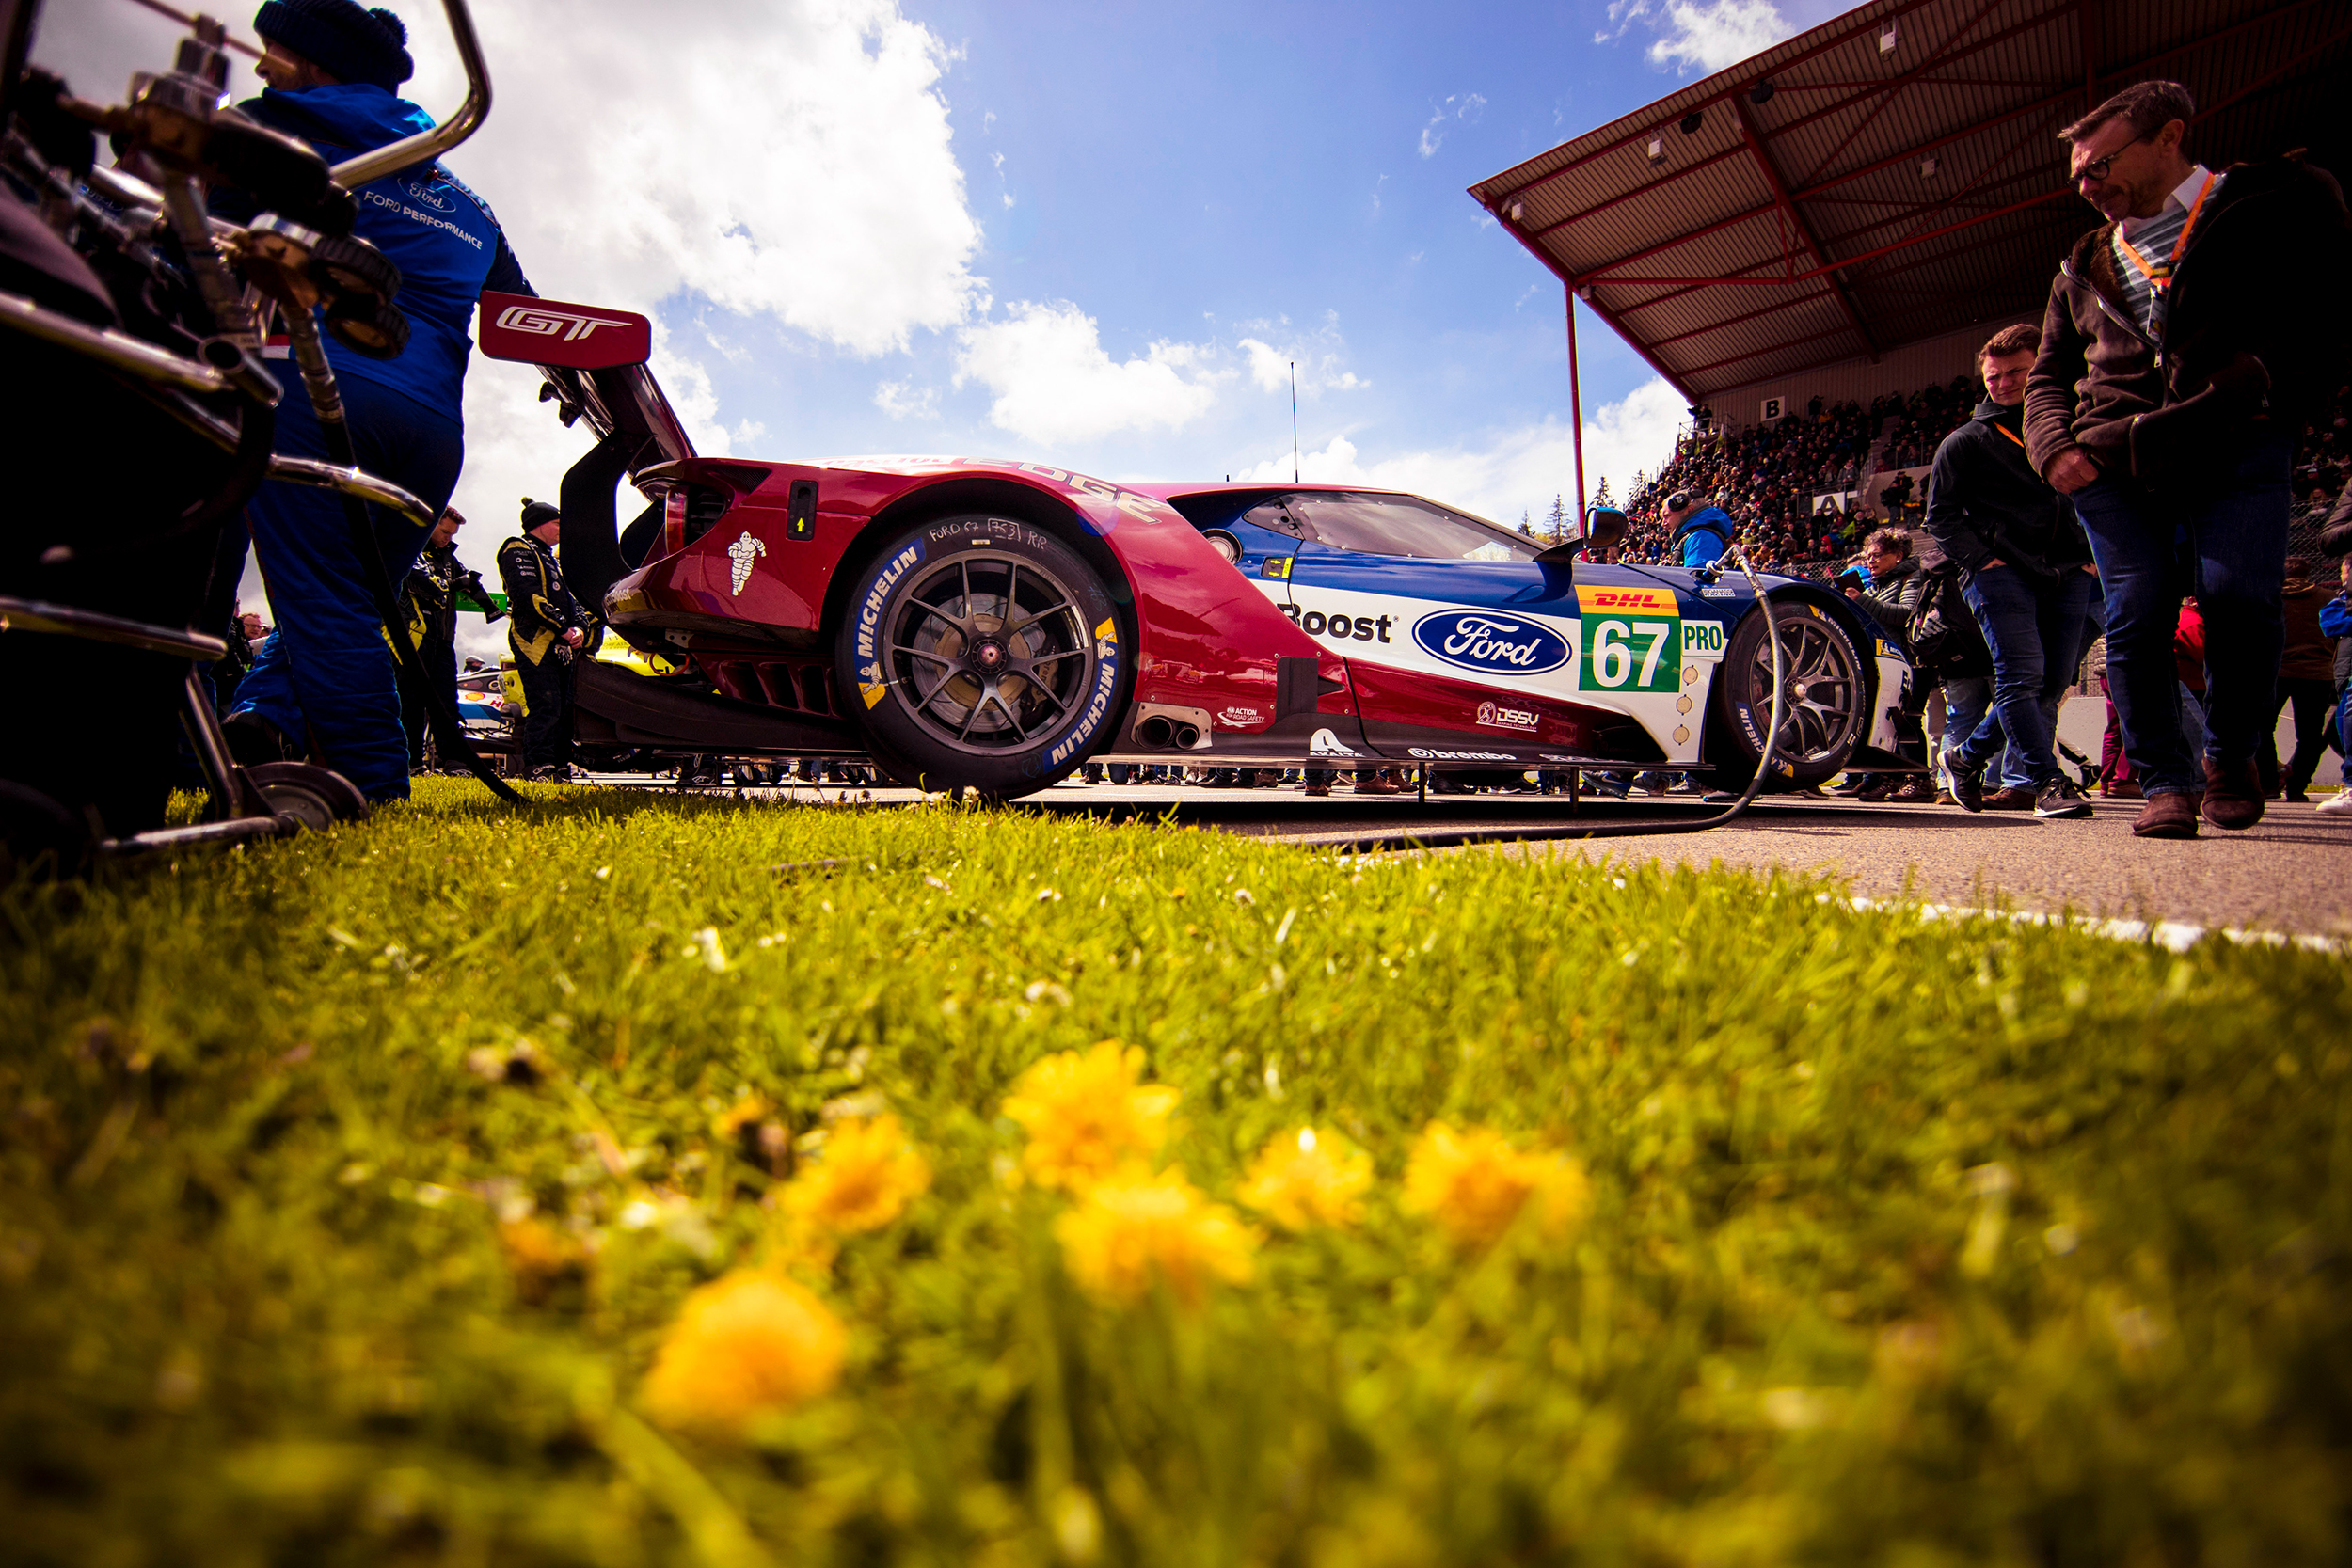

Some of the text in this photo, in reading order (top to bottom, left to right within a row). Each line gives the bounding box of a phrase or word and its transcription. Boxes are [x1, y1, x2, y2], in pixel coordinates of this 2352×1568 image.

[363, 191, 483, 251] FORD PERFORMANCE
[496, 306, 633, 341] GT
[1765, 399, 1780, 420] B
[962, 455, 1163, 526] EDGE
[1819, 495, 1843, 515] A
[963, 521, 979, 532] 67
[1027, 531, 1048, 550] RR
[857, 546, 918, 658] MICHELIN
[1594, 592, 1661, 609] DHL
[1443, 616, 1542, 666] Ford
[1592, 619, 1670, 689] 67
[1684, 625, 1723, 651] PRO
[1827, 617, 1862, 671] MICHELIN
[1051, 661, 1115, 766] MICHELIN
[1235, 707, 1257, 716] ACTION
[1496, 707, 1540, 726] DSSV
[1429, 749, 1518, 761] brembo
